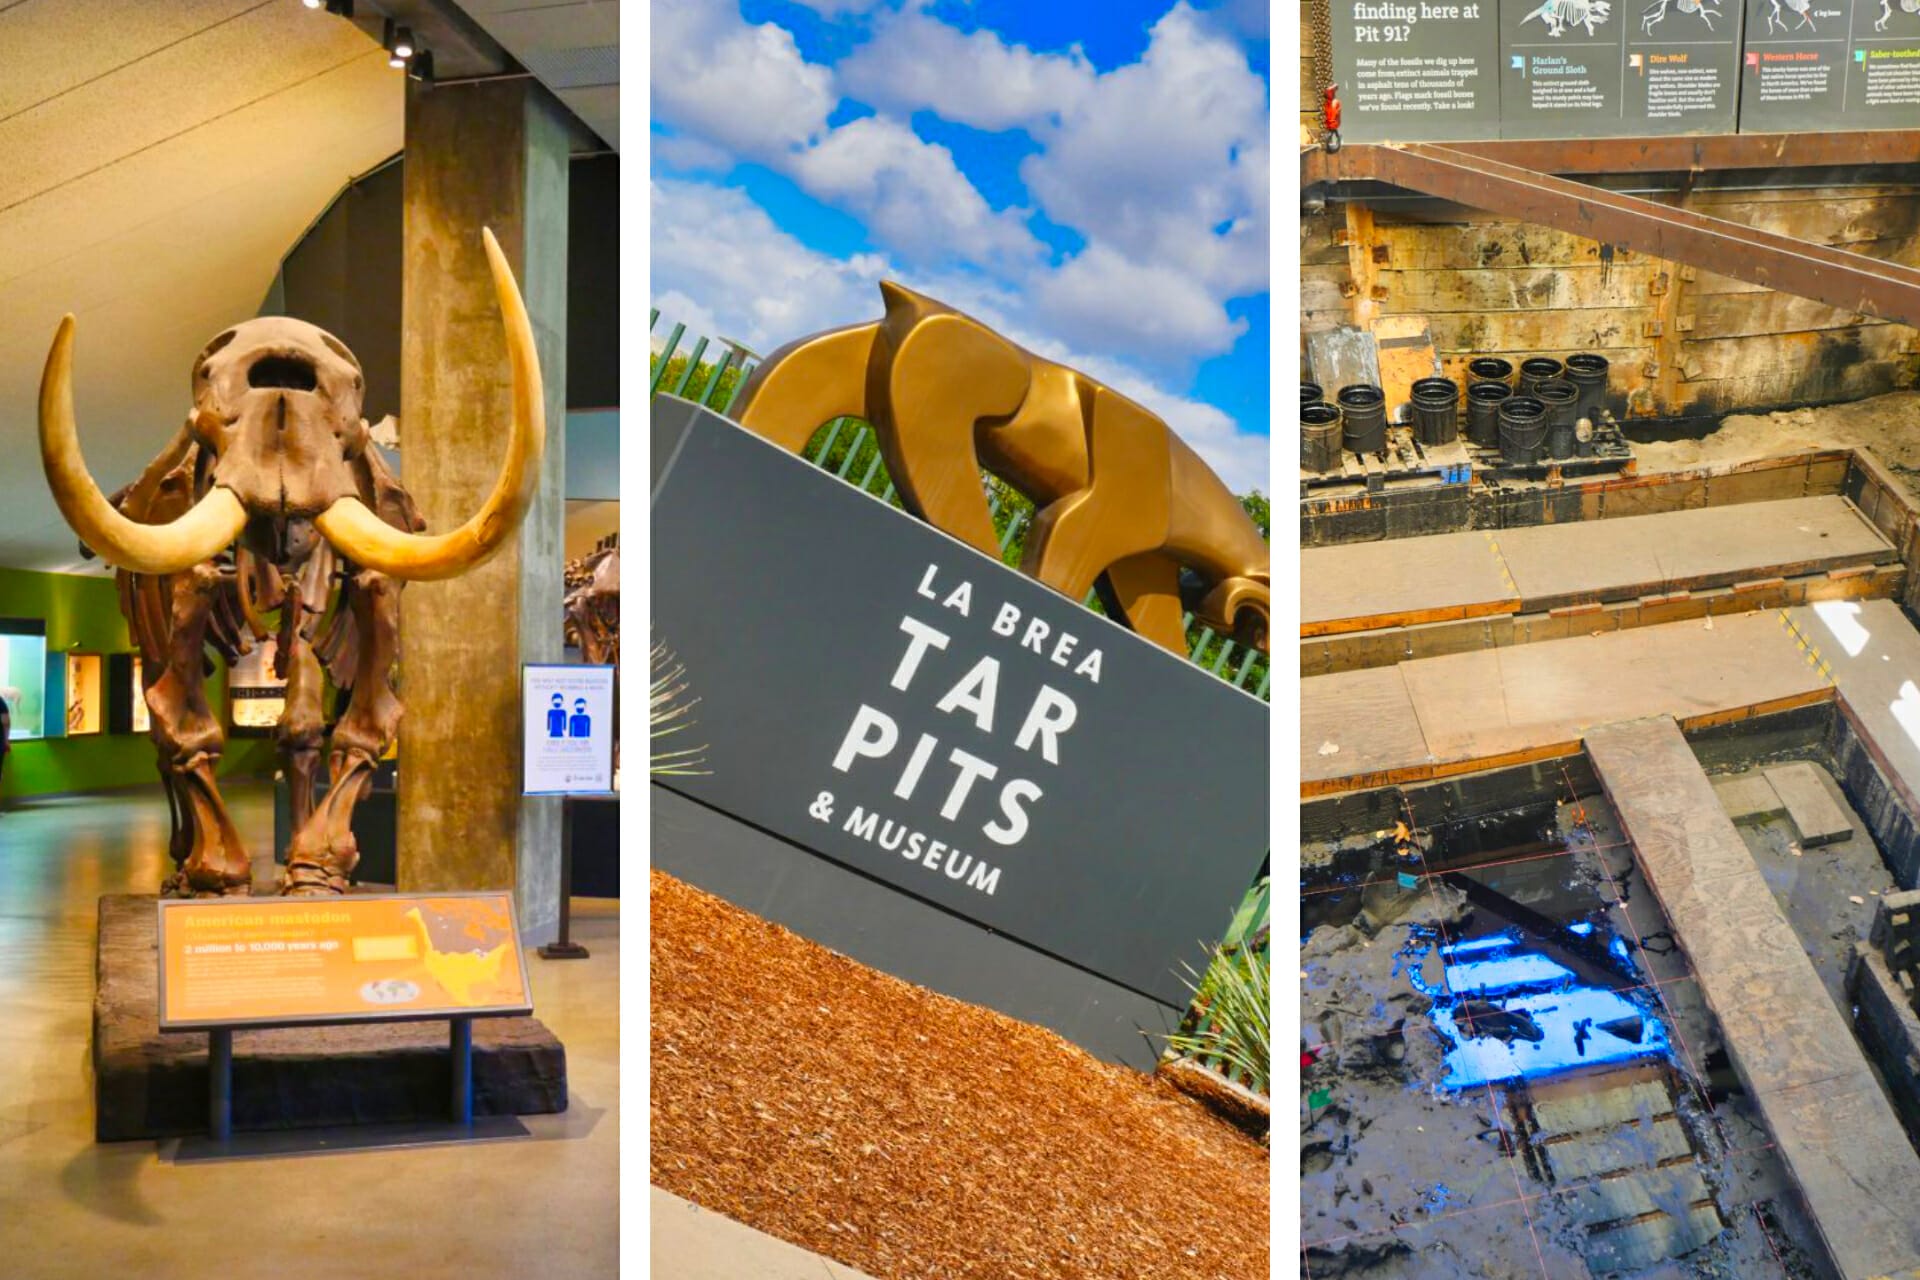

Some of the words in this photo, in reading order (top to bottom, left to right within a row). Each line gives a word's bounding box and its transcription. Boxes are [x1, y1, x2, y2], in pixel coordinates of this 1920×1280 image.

[1354, 2, 1417, 24] finding
[1421, 2, 1459, 19] here
[1464, 3, 1480, 19] at
[1355, 26, 1380, 42] Pit
[1384, 26, 1410, 42] 91?
[1356, 58, 1377, 68] Many
[1387, 58, 1399, 66] the
[1400, 57, 1423, 66] fossils
[1436, 57, 1448, 67] dig
[1458, 56, 1475, 65] here
[1532, 56, 1567, 65] Harlan's
[1650, 55, 1667, 63] Dire
[1668, 54, 1688, 63] Wolf
[1763, 53, 1794, 61] Western
[1396, 69, 1421, 77] extinct
[1422, 69, 1450, 77] animals
[1451, 68, 1478, 78] trapped
[1532, 66, 1564, 74] Ground
[1565, 65, 1587, 74] Sloth
[1367, 81, 1393, 91] asphalt
[1419, 80, 1455, 88] thousands
[1358, 93, 1378, 102] years
[1394, 91, 1413, 101] Flags
[1414, 91, 1432, 99] mark
[1434, 90, 1452, 99] fossil
[1454, 90, 1474, 98] bones
[1380, 103, 1402, 111] found
[1433, 102, 1450, 110] Take
[917, 563, 973, 617] LA
[991, 601, 1103, 683] BREA
[890, 615, 1078, 765] TAR
[831, 703, 1043, 845] PITS
[808, 790, 834, 823] &
[842, 806, 1002, 895] MUSEUM
[185, 915, 264, 928] American
[270, 912, 351, 925] mastodon
[194, 943, 232, 953] million
[235, 943, 246, 953] to
[249, 941, 286, 952] 10,000
[287, 941, 316, 952] years
[319, 941, 339, 952] ago
